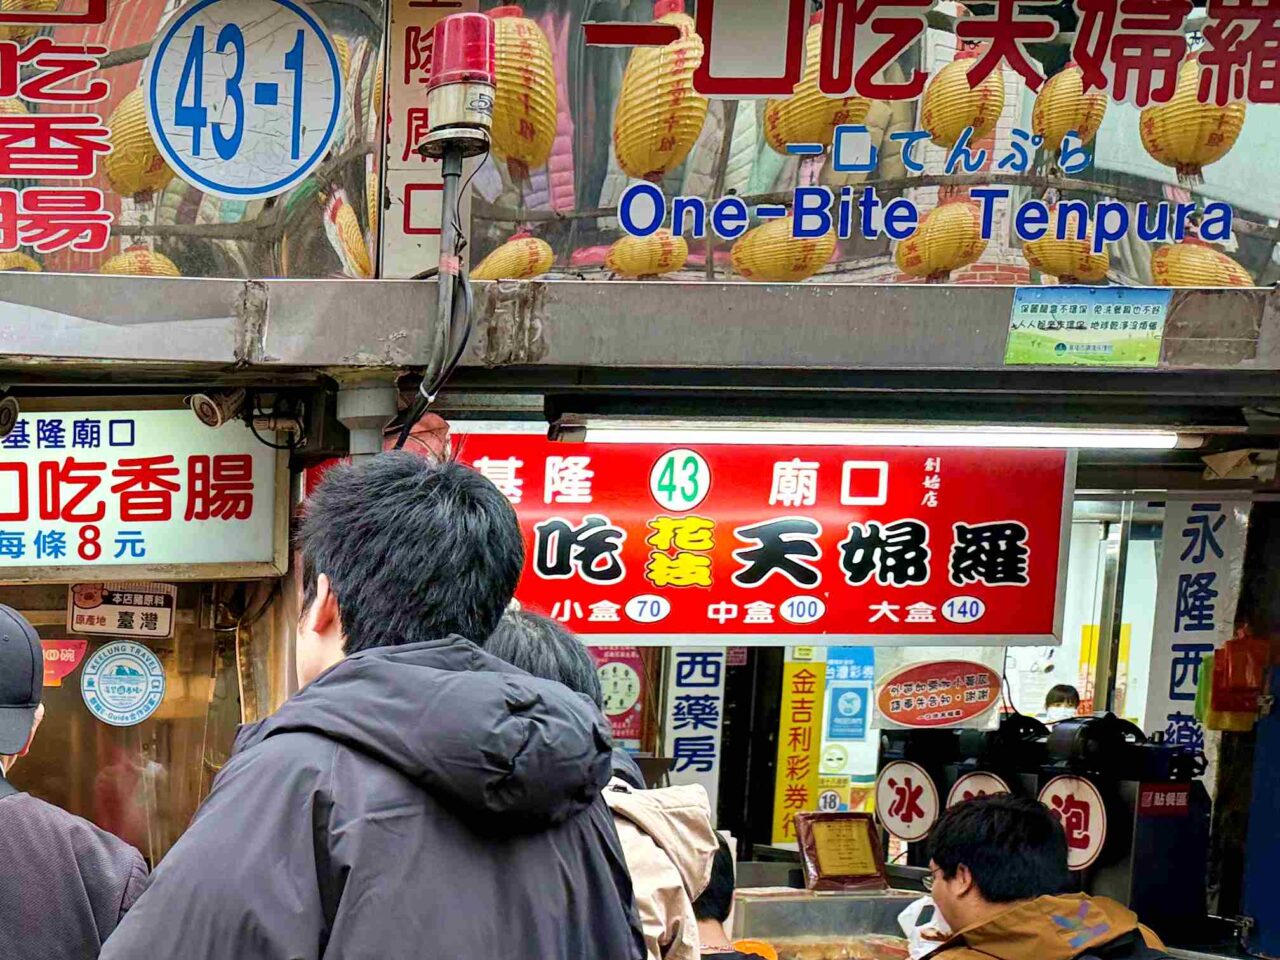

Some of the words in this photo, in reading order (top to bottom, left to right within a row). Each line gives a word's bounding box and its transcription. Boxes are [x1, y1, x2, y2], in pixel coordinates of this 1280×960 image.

[173, 24, 306, 163] 43-1
[619, 183, 918, 240] One-Bite
[970, 188, 1234, 254] Tenpura
[1, 418, 136, 448] 基隆廟口
[656, 457, 701, 505] 43
[769, 459, 888, 507] 廟口
[75, 614, 107, 627] 原產地
[116, 610, 160, 631] 臺灣
[551, 600, 621, 622] 小盒
[637, 601, 660, 618] 70
[706, 602, 775, 624] 中盒
[787, 600, 818, 620] 100
[869, 602, 936, 623] 大盒
[948, 600, 980, 619] 140
[90, 645, 128, 671] KEELUNG
[129, 645, 160, 672] TRAVEL
[669, 652, 724, 773] 西藥房
[822, 794, 838, 810] 18
[887, 776, 926, 824] 冰
